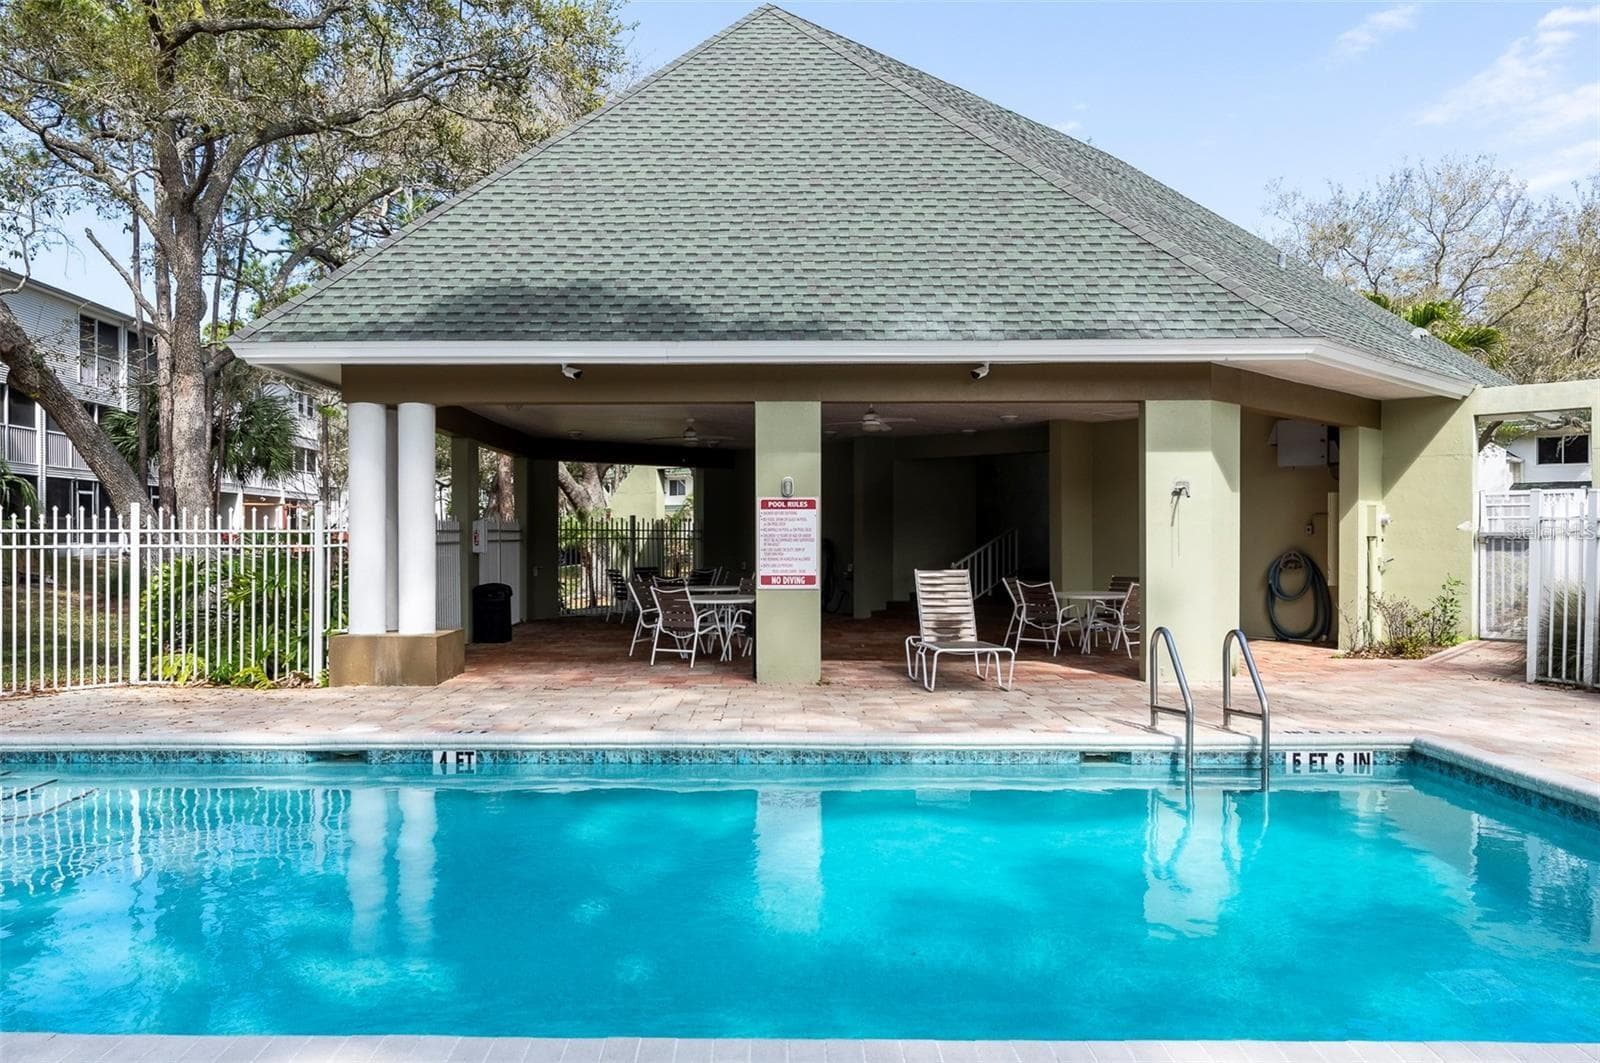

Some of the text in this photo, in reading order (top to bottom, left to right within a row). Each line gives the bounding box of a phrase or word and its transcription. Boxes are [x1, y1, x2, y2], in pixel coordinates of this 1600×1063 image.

[771, 576, 806, 585] NO DIVING
[1353, 752, 1371, 765] IN
